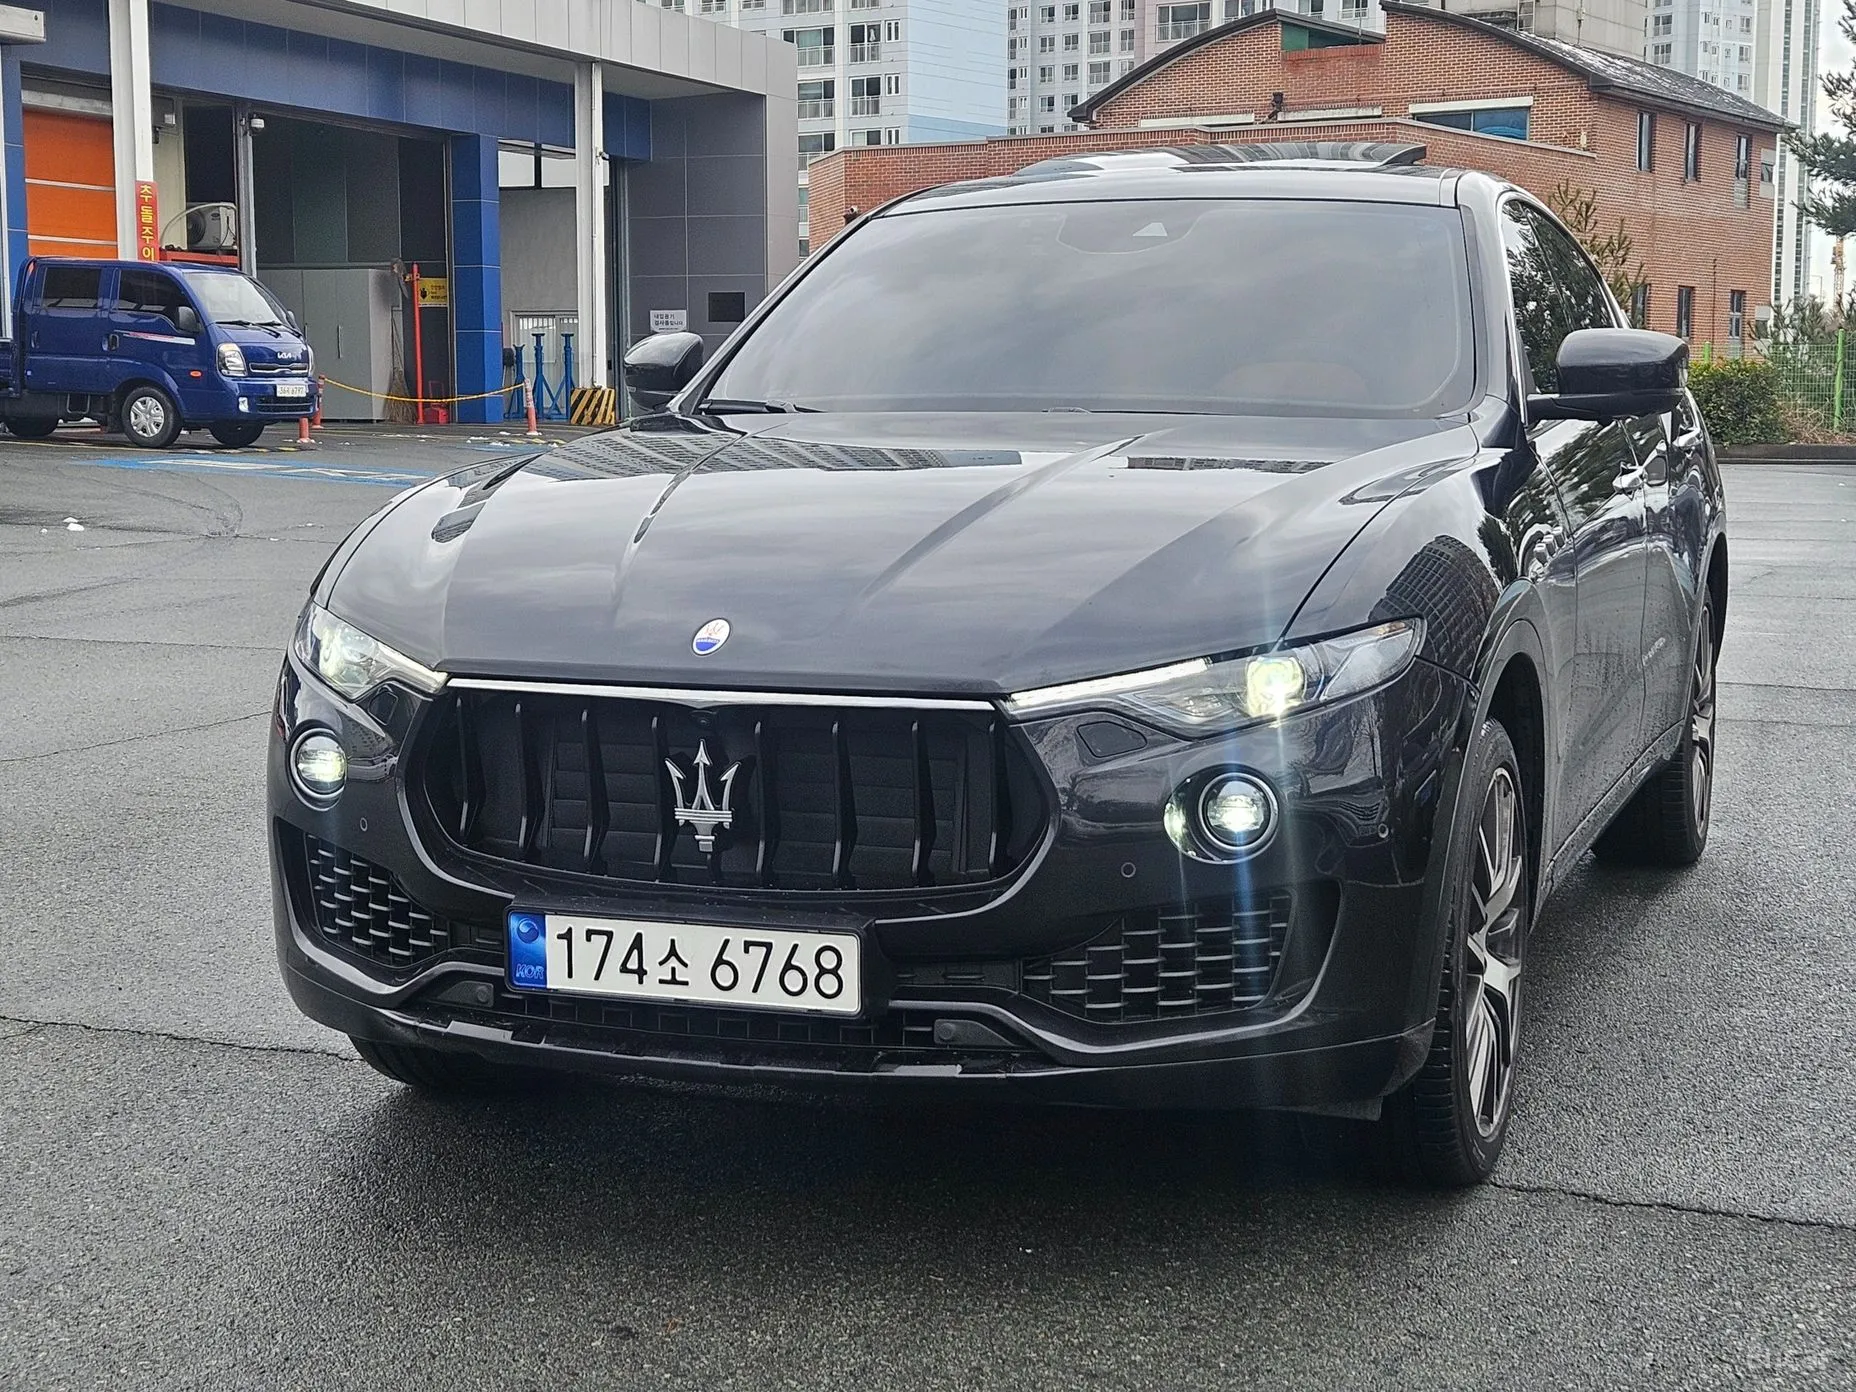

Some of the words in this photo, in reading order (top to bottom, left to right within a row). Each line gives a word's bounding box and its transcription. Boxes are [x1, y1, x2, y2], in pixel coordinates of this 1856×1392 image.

[515, 963, 545, 980] KOR
[556, 926, 690, 986] 174소
[709, 937, 844, 1000] 6768
